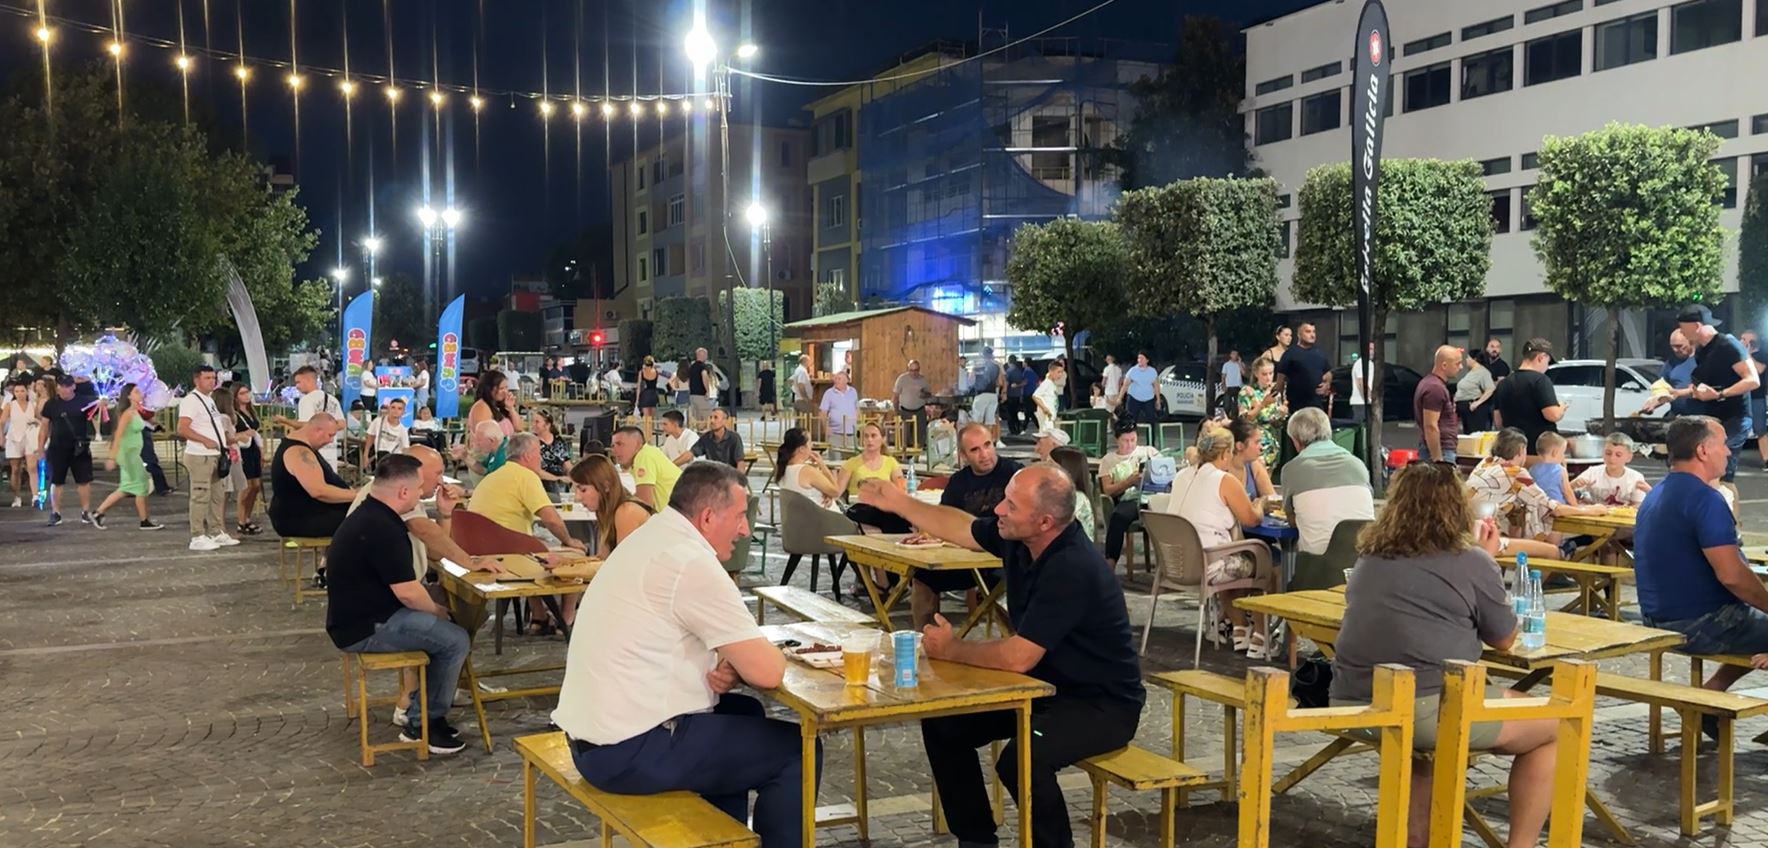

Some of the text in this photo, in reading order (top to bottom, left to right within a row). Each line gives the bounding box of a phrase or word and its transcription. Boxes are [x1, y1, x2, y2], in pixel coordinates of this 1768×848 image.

[1360, 74, 1379, 295] Estrella Galicia
[440, 333, 458, 391] JUMBO
